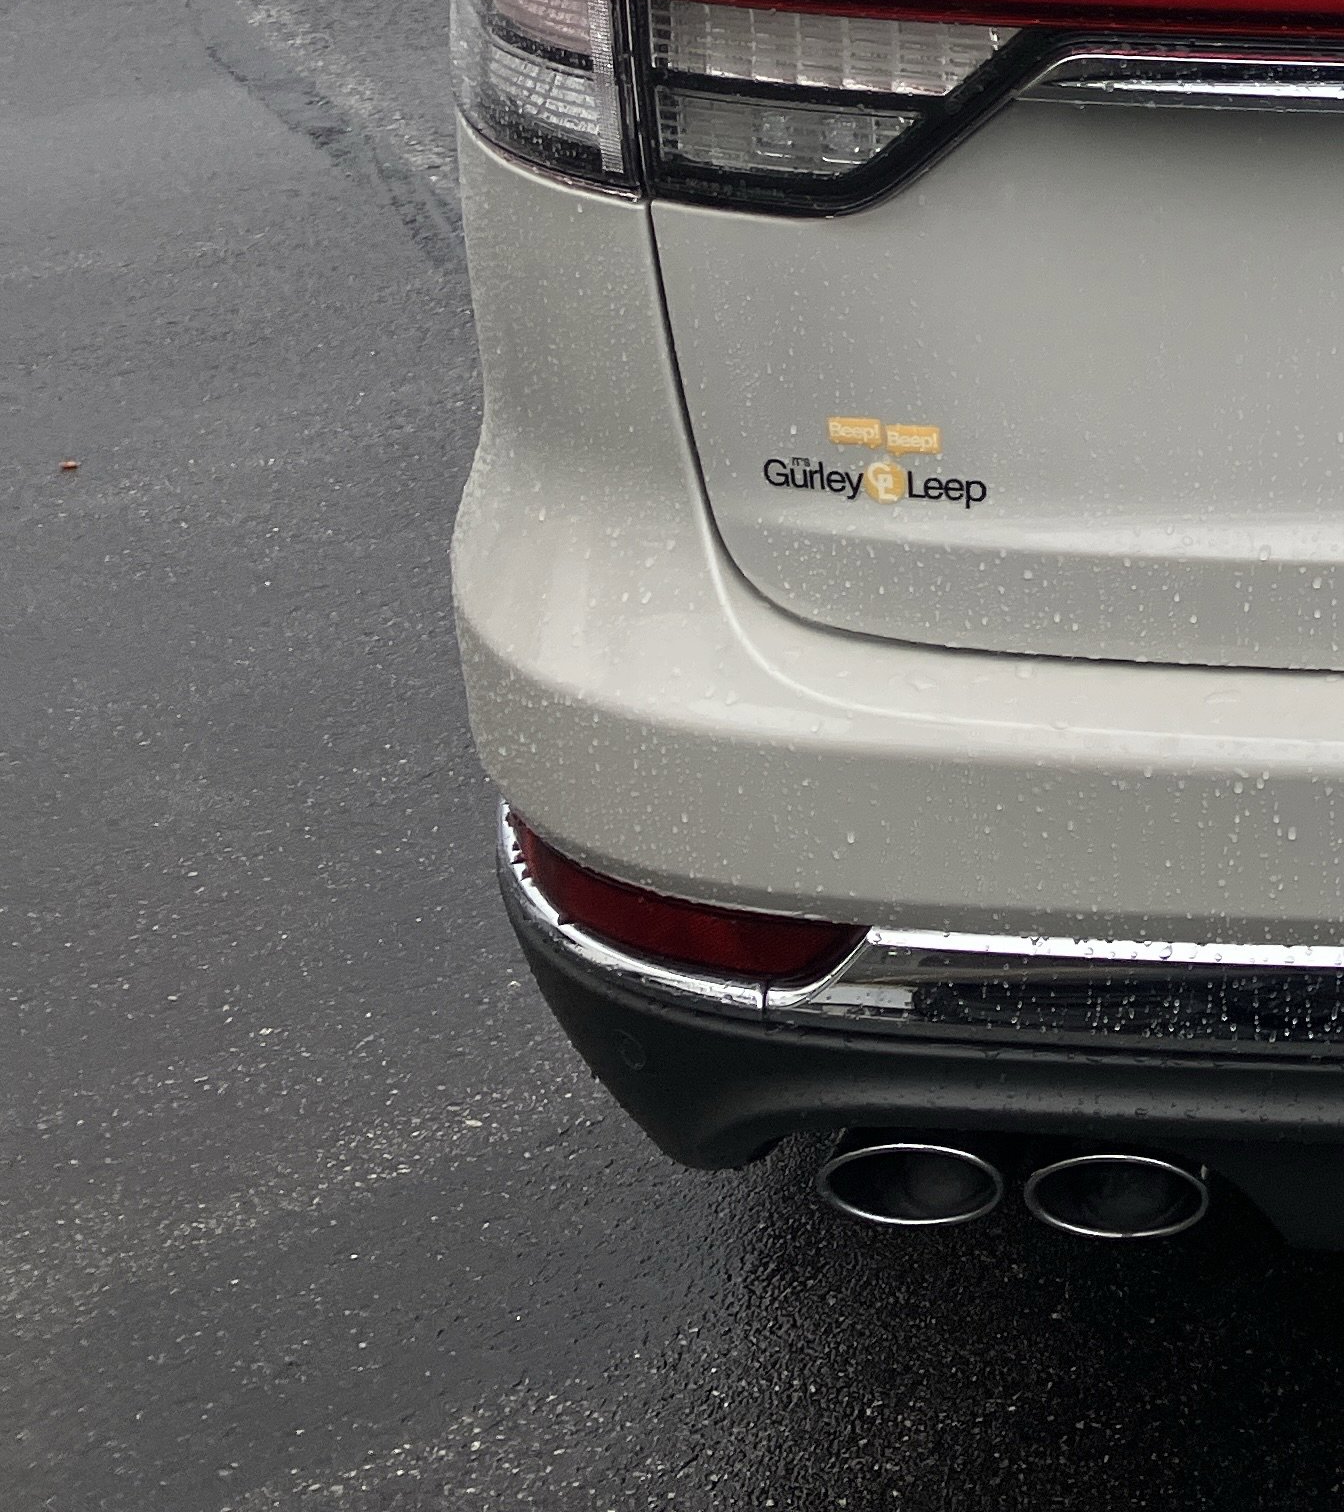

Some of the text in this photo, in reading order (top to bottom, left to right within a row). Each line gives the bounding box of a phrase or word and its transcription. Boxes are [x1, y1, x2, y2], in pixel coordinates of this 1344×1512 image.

[828, 422, 939, 449] Beep! Beep!
[907, 471, 987, 509] Leep
